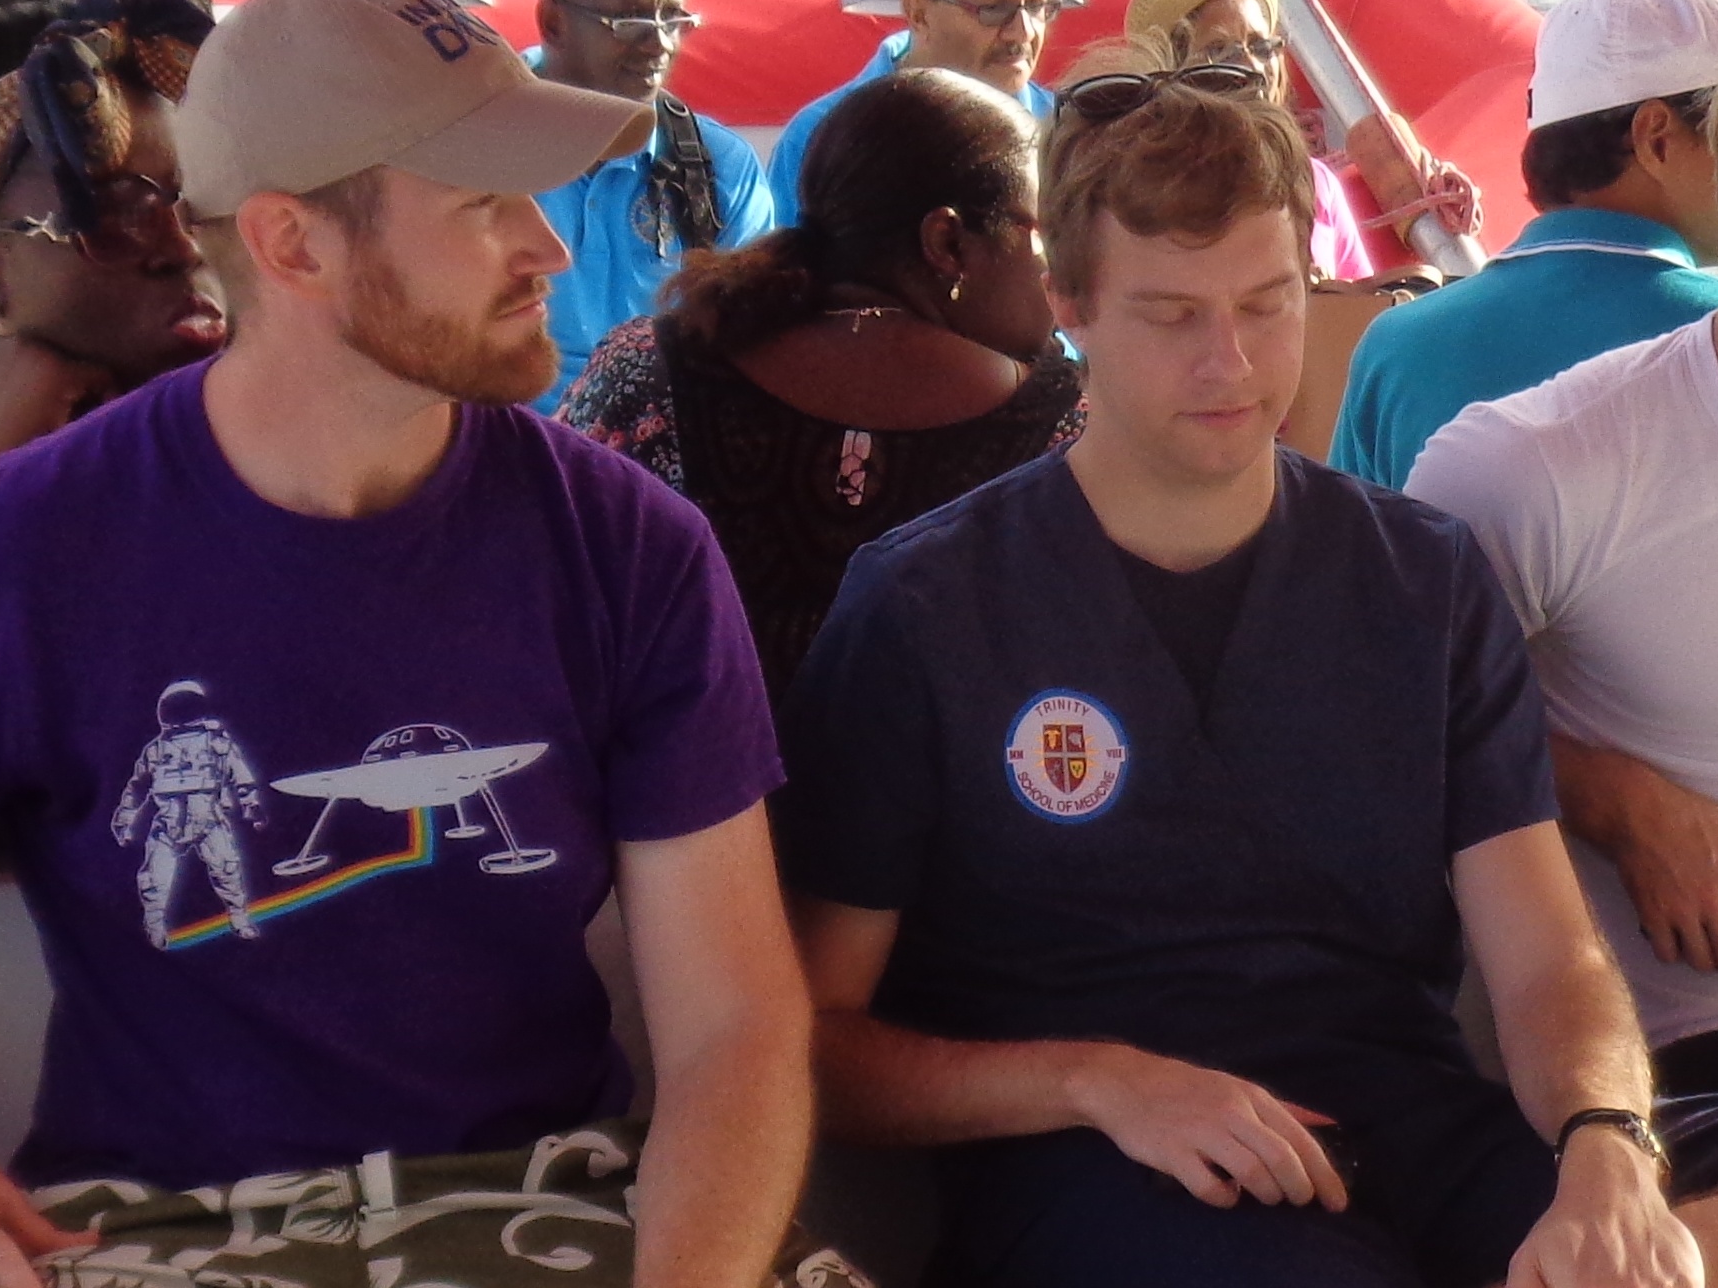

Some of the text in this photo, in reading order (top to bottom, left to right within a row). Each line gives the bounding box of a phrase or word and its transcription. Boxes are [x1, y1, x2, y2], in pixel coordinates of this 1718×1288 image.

[1035, 698, 1091, 717] TRINITY
[1017, 770, 1116, 813] SCHOOL OF MEDICINE
